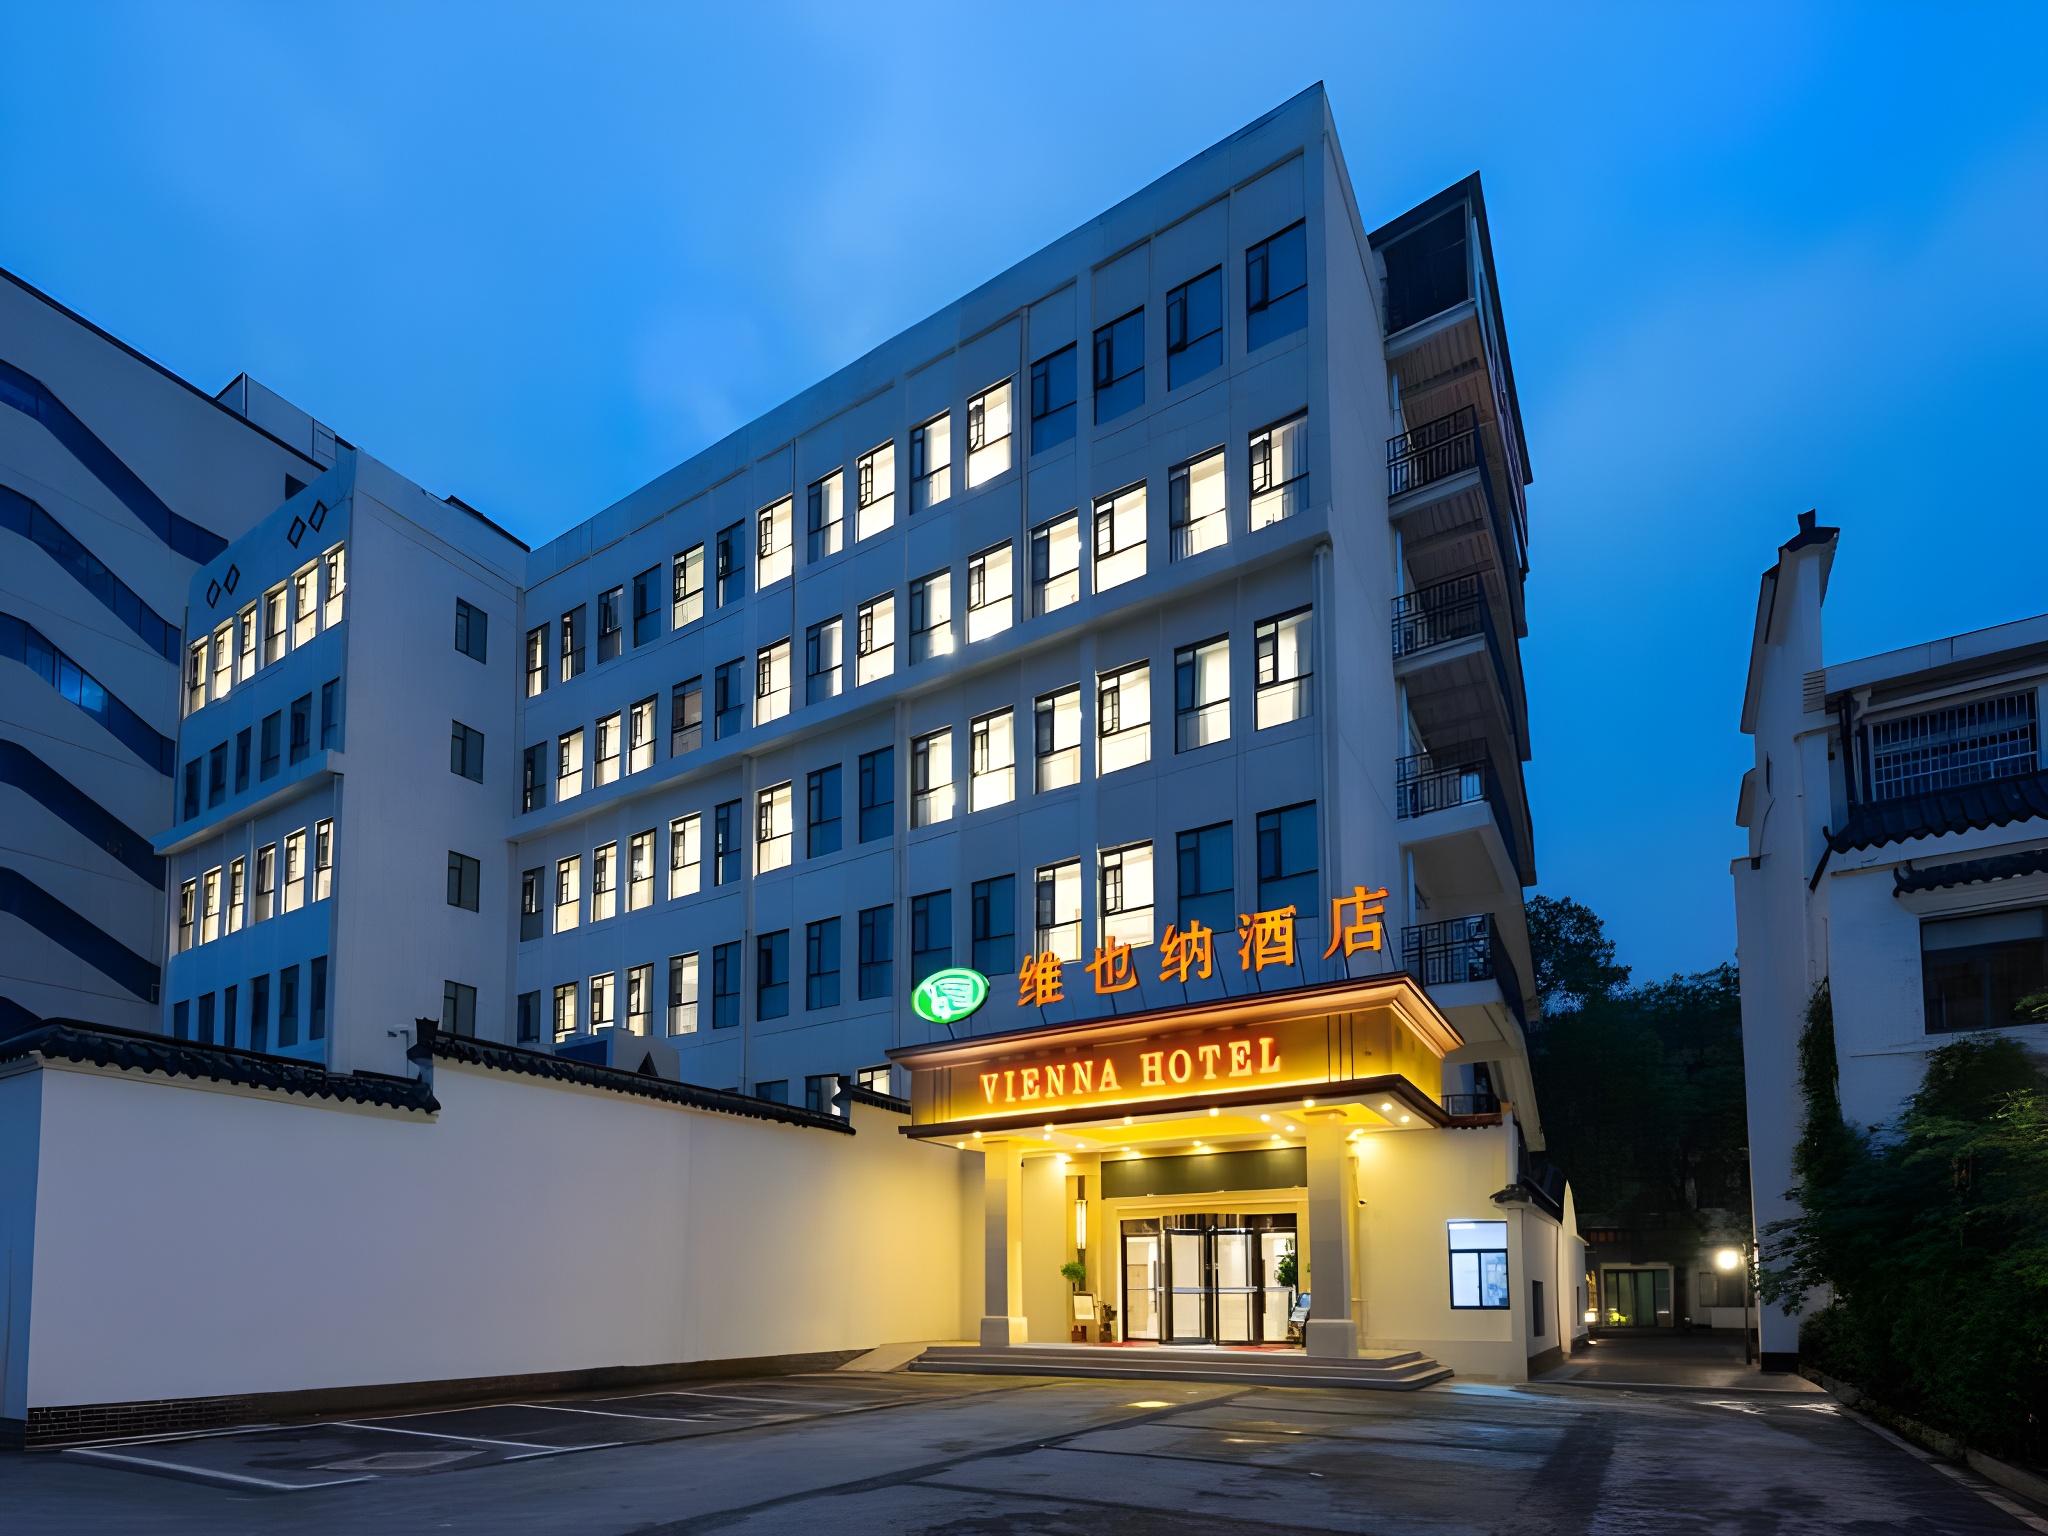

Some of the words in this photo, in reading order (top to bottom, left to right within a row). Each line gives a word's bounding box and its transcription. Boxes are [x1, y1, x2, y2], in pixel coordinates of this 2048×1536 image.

[1017, 886, 1389, 1007] 维也纳酒店
[980, 1058, 1121, 1104] VIENNA
[1140, 1037, 1282, 1087] HOTEL
